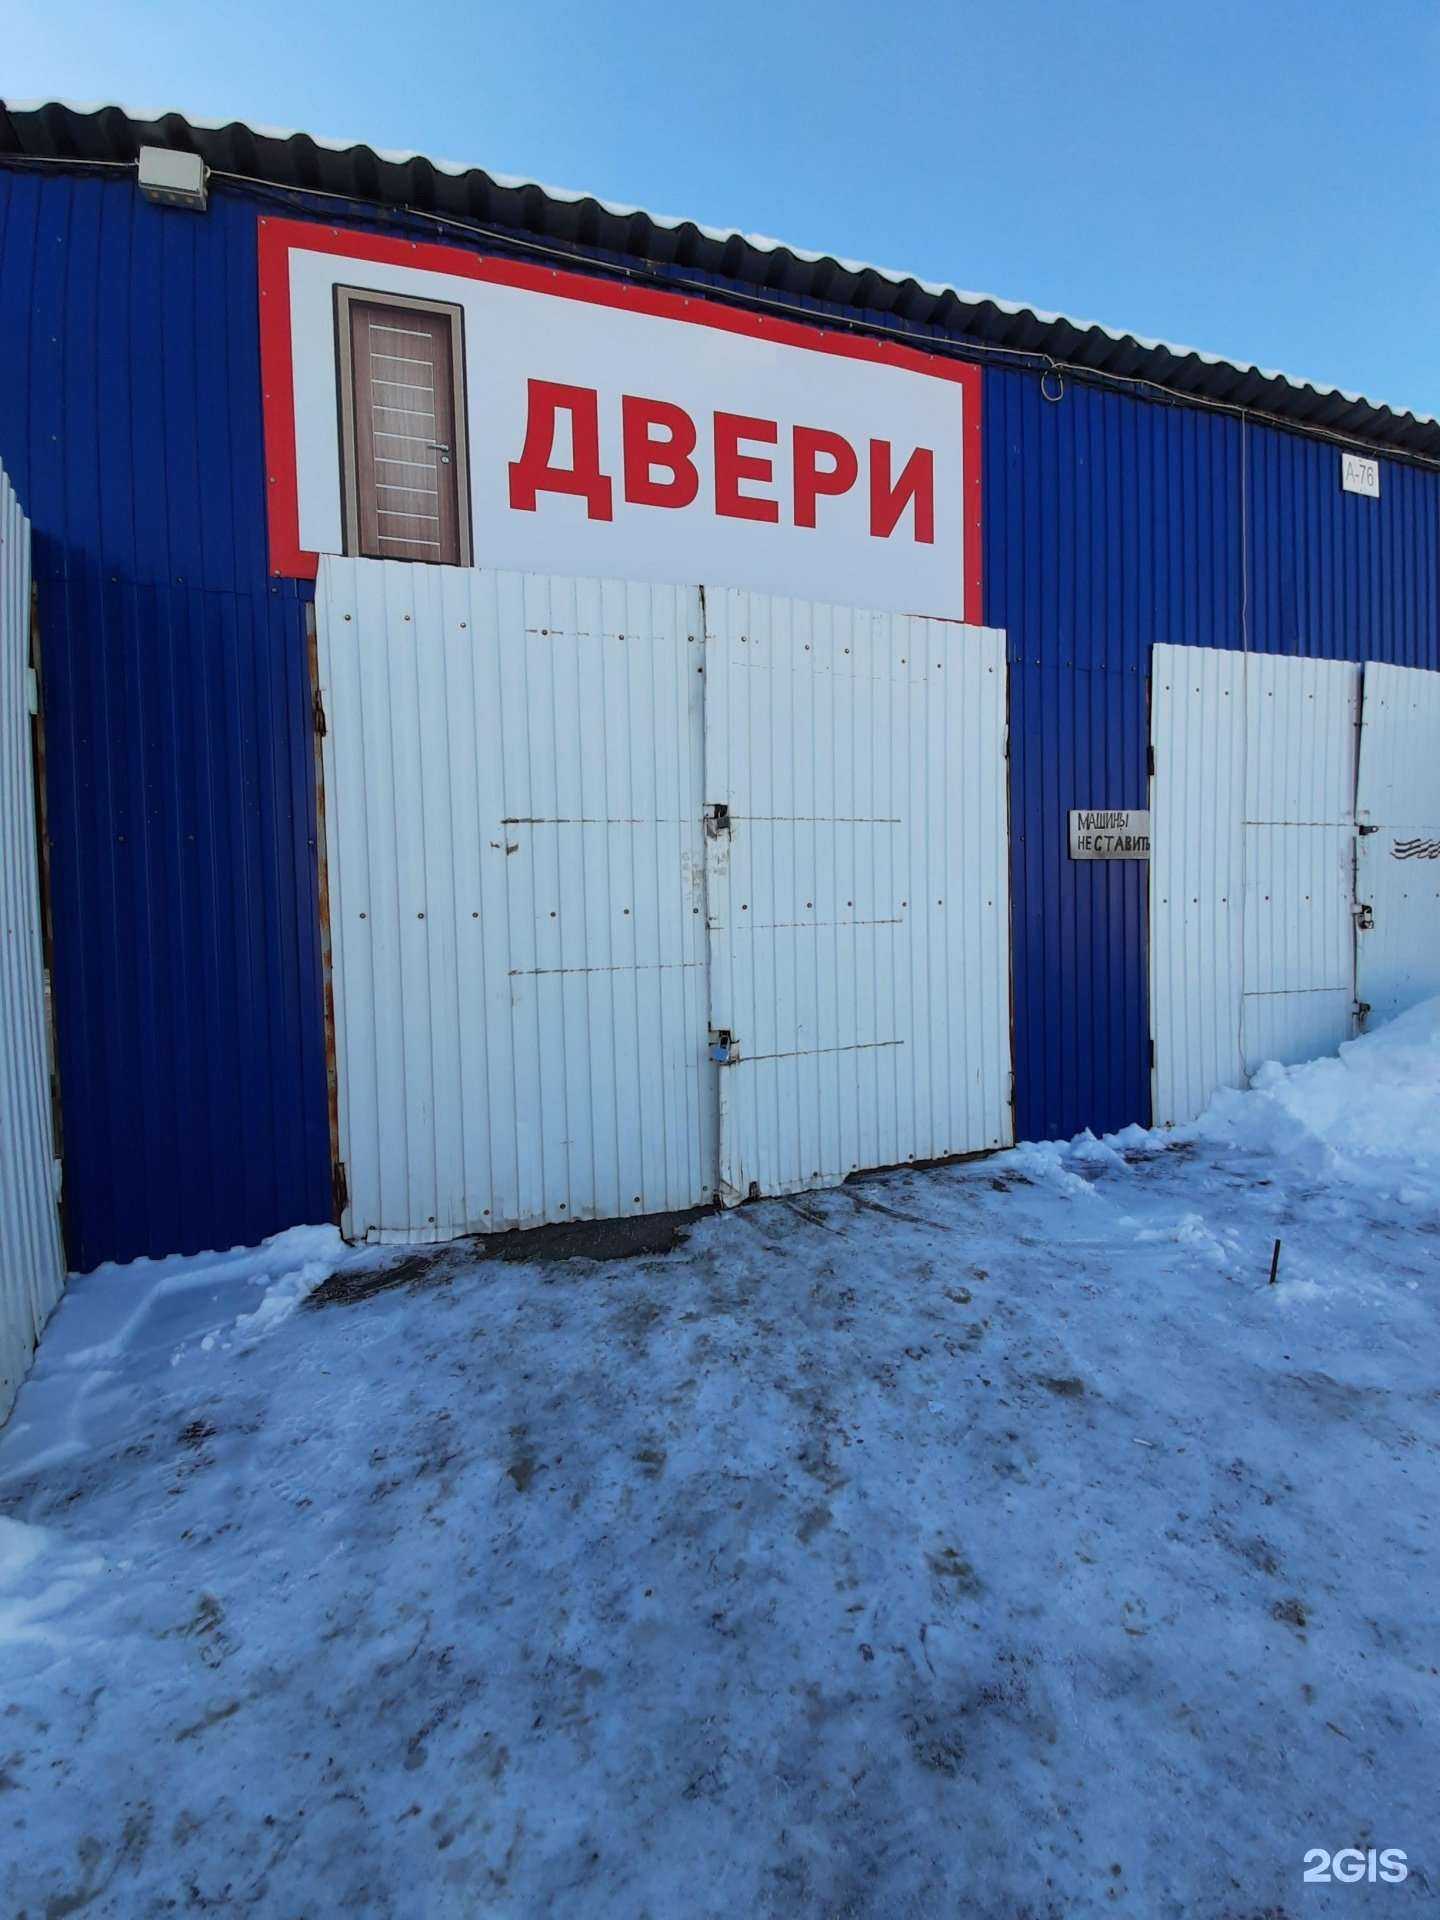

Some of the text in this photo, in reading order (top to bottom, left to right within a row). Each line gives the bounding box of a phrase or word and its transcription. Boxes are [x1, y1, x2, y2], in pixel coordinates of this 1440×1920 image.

[508, 378, 935, 545] ДВЕРИ
[1345, 461, 1375, 487] А-76
[1077, 812, 1129, 831] МАШИНЫ
[1077, 835, 1150, 852] НЕ СТАВИТЬ
